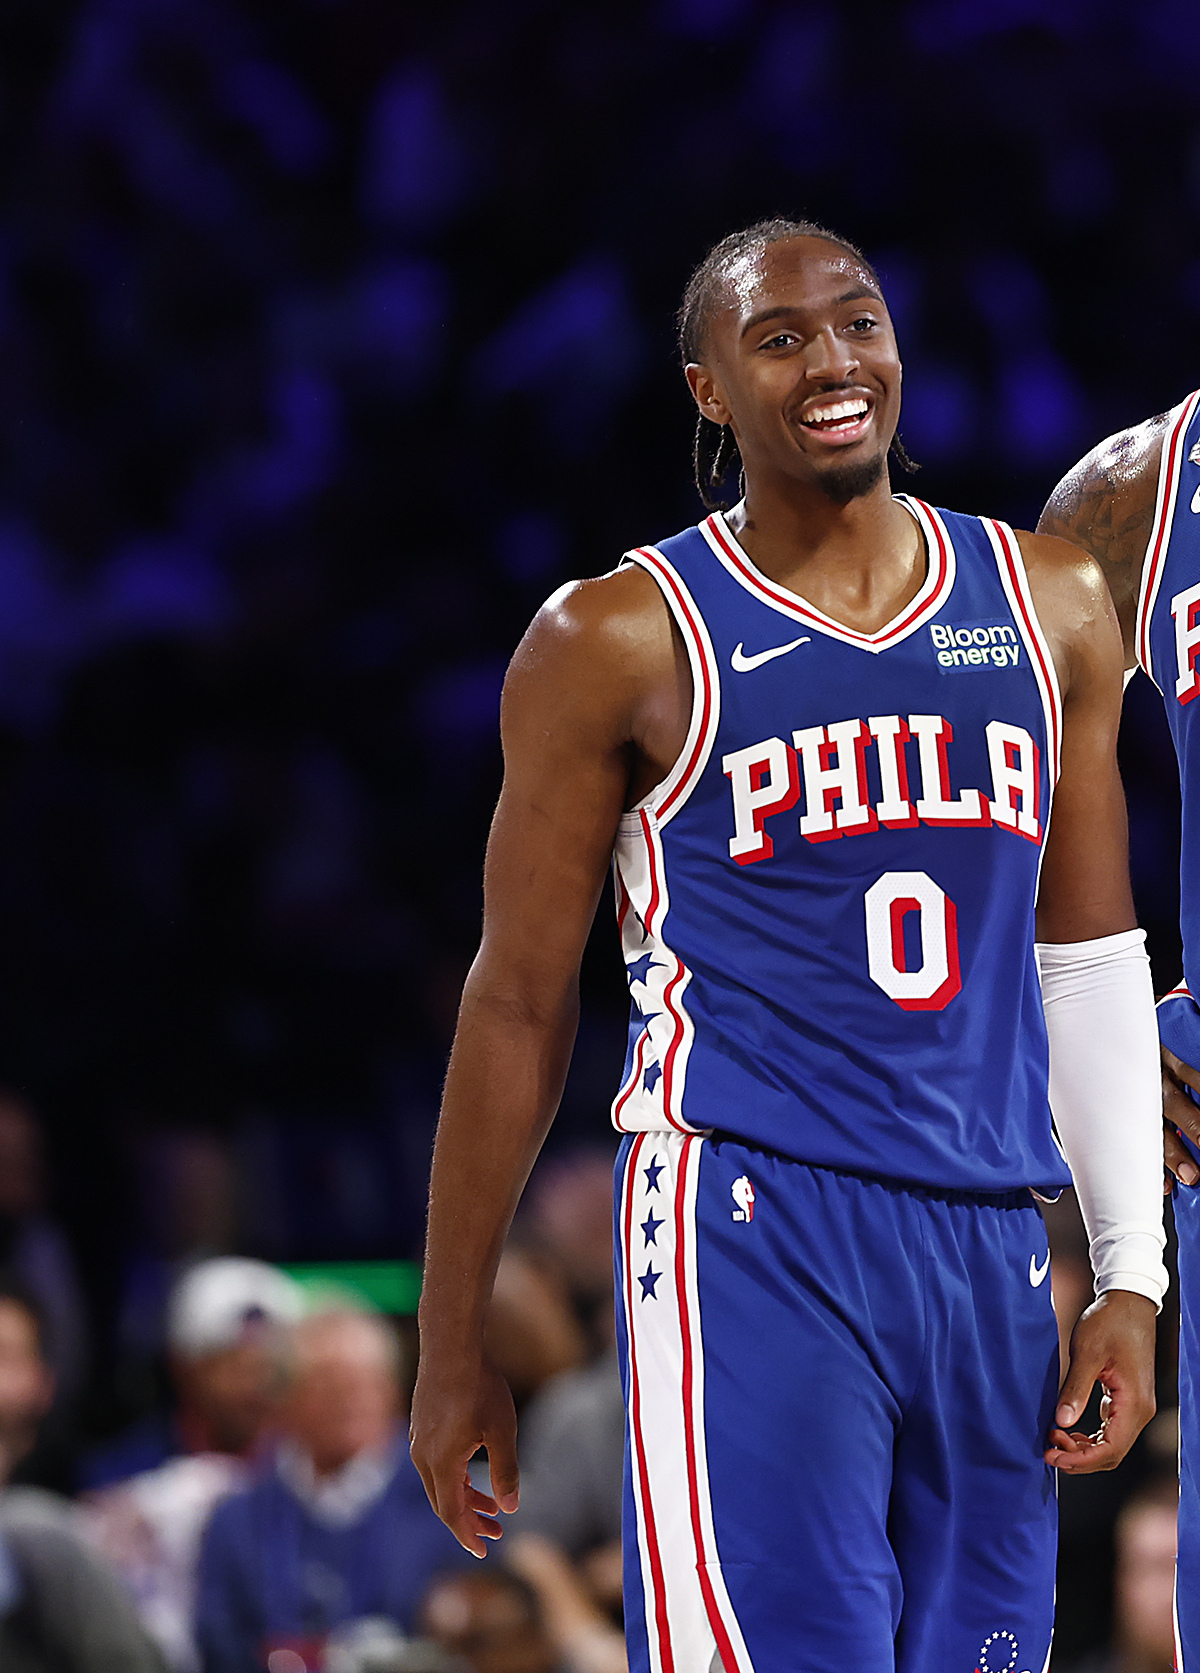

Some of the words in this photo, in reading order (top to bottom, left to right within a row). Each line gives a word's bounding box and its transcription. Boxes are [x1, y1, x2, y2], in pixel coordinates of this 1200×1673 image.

[930, 624, 1017, 649] Bloom
[937, 645, 1019, 667] energy
[722, 714, 1042, 867] PHILA
[864, 871, 962, 1011] 0
